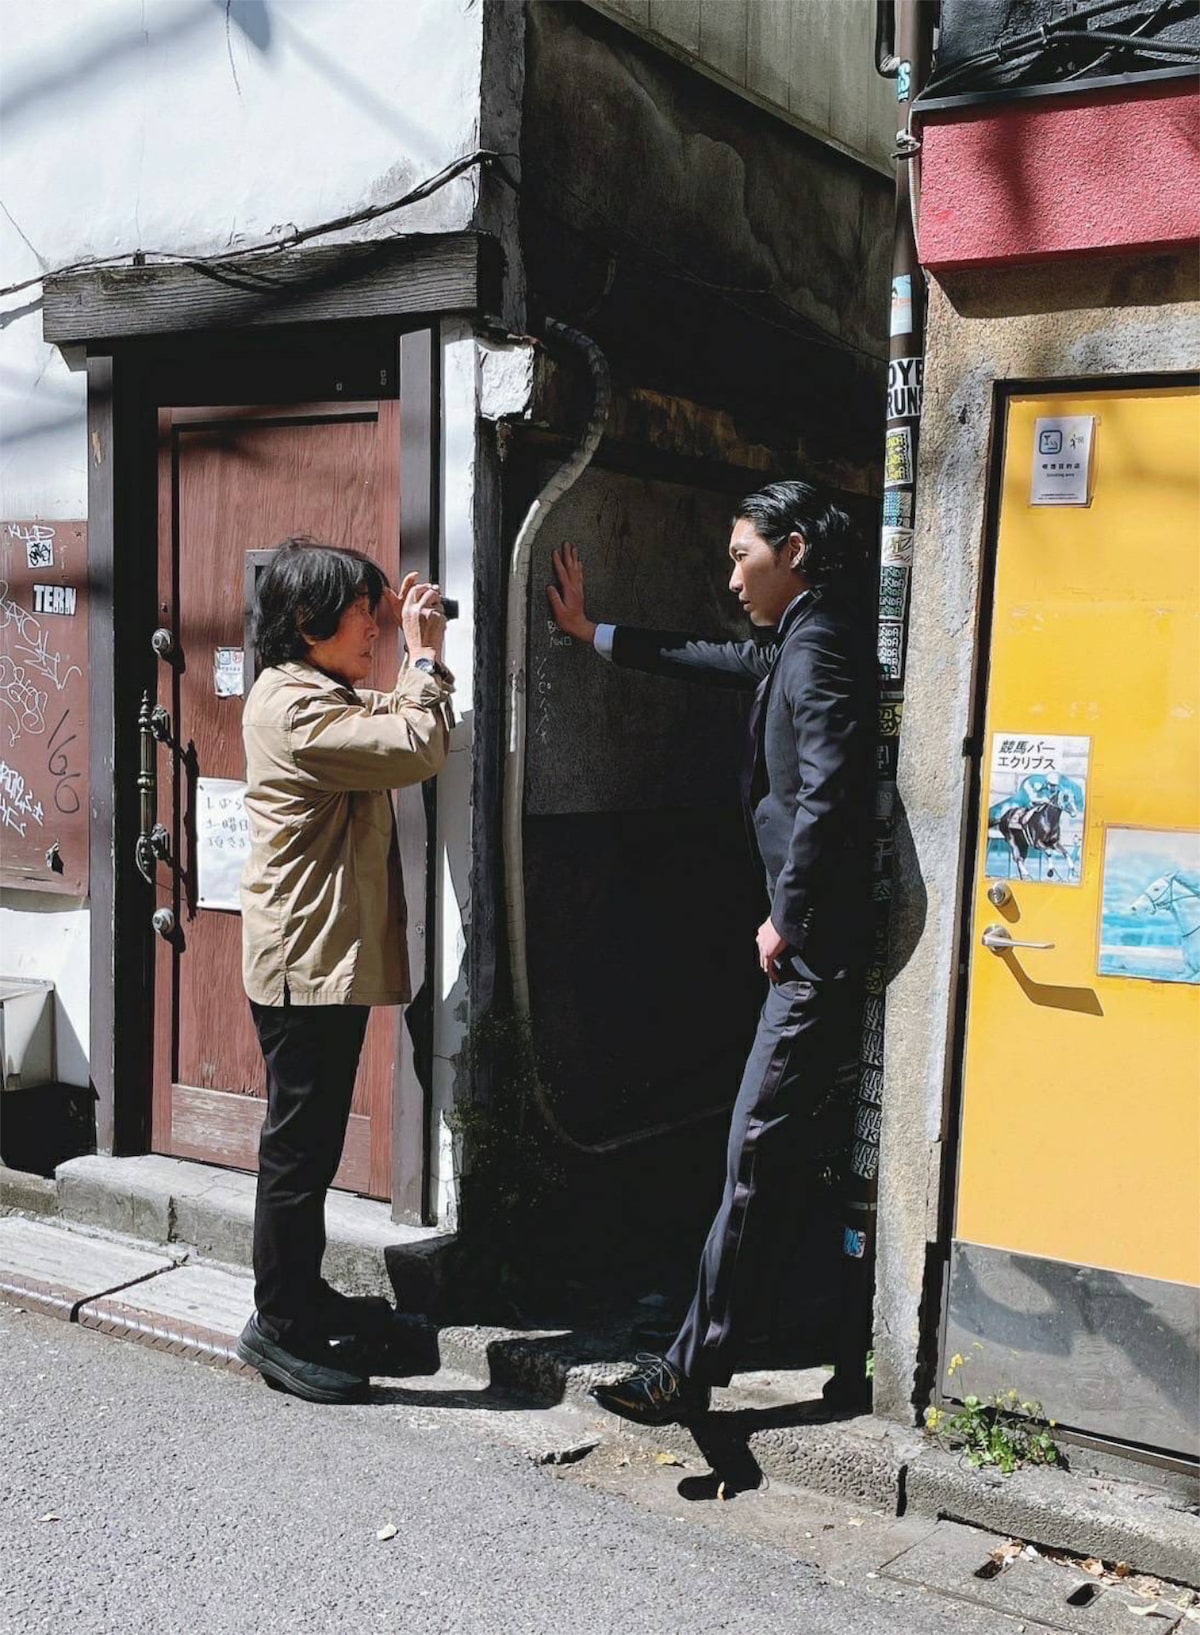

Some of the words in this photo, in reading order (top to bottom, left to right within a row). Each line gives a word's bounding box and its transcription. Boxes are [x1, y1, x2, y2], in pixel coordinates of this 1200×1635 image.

[887, 387, 923, 417] RUN
[33, 584, 77, 615] TERN
[998, 740, 1056, 754] 競馬バー
[997, 755, 1056, 770] エクリプス
